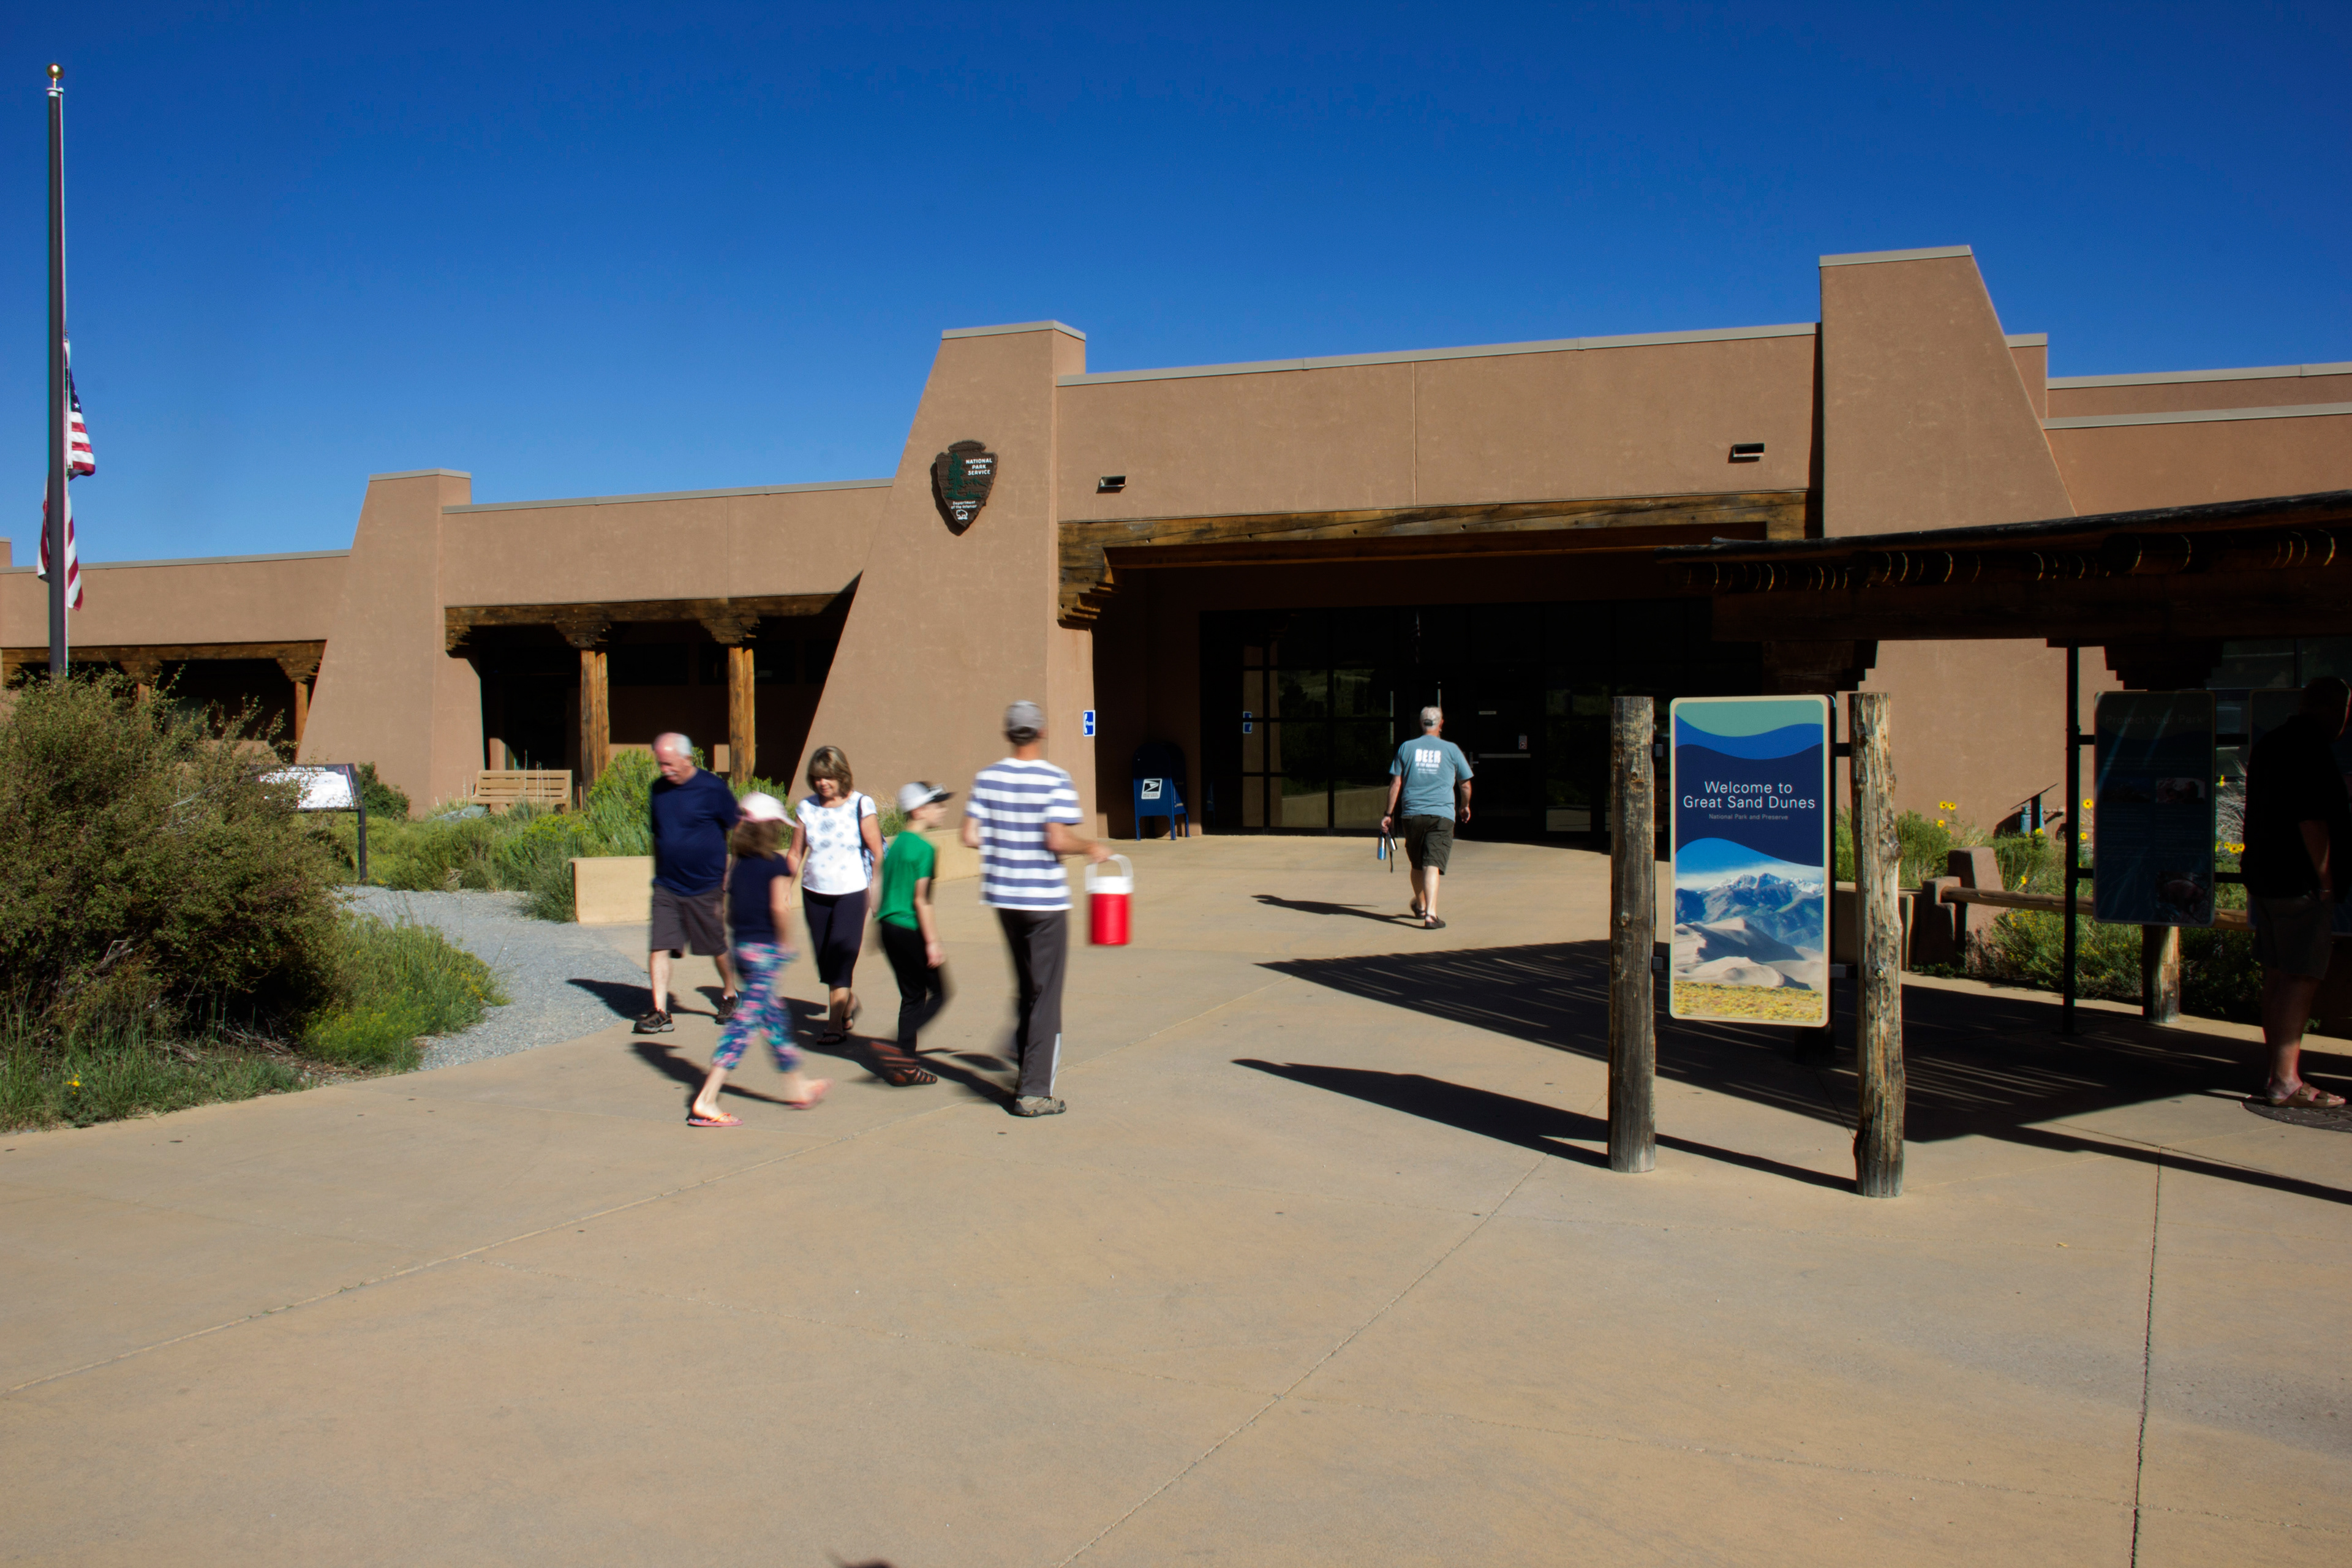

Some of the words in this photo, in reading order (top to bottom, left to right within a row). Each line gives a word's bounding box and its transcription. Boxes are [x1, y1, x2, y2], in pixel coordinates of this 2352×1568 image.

[2106, 715, 2146, 725] Protect
[2149, 715, 2174, 725] Your
[2179, 714, 2203, 724] Park
[1415, 748, 1441, 763] BEER
[1704, 781, 1772, 793] Welcome
[1777, 782, 1793, 793] to
[1683, 795, 1722, 808] Great
[1727, 795, 1763, 808] Sand
[1768, 796, 1815, 809] Dunes
